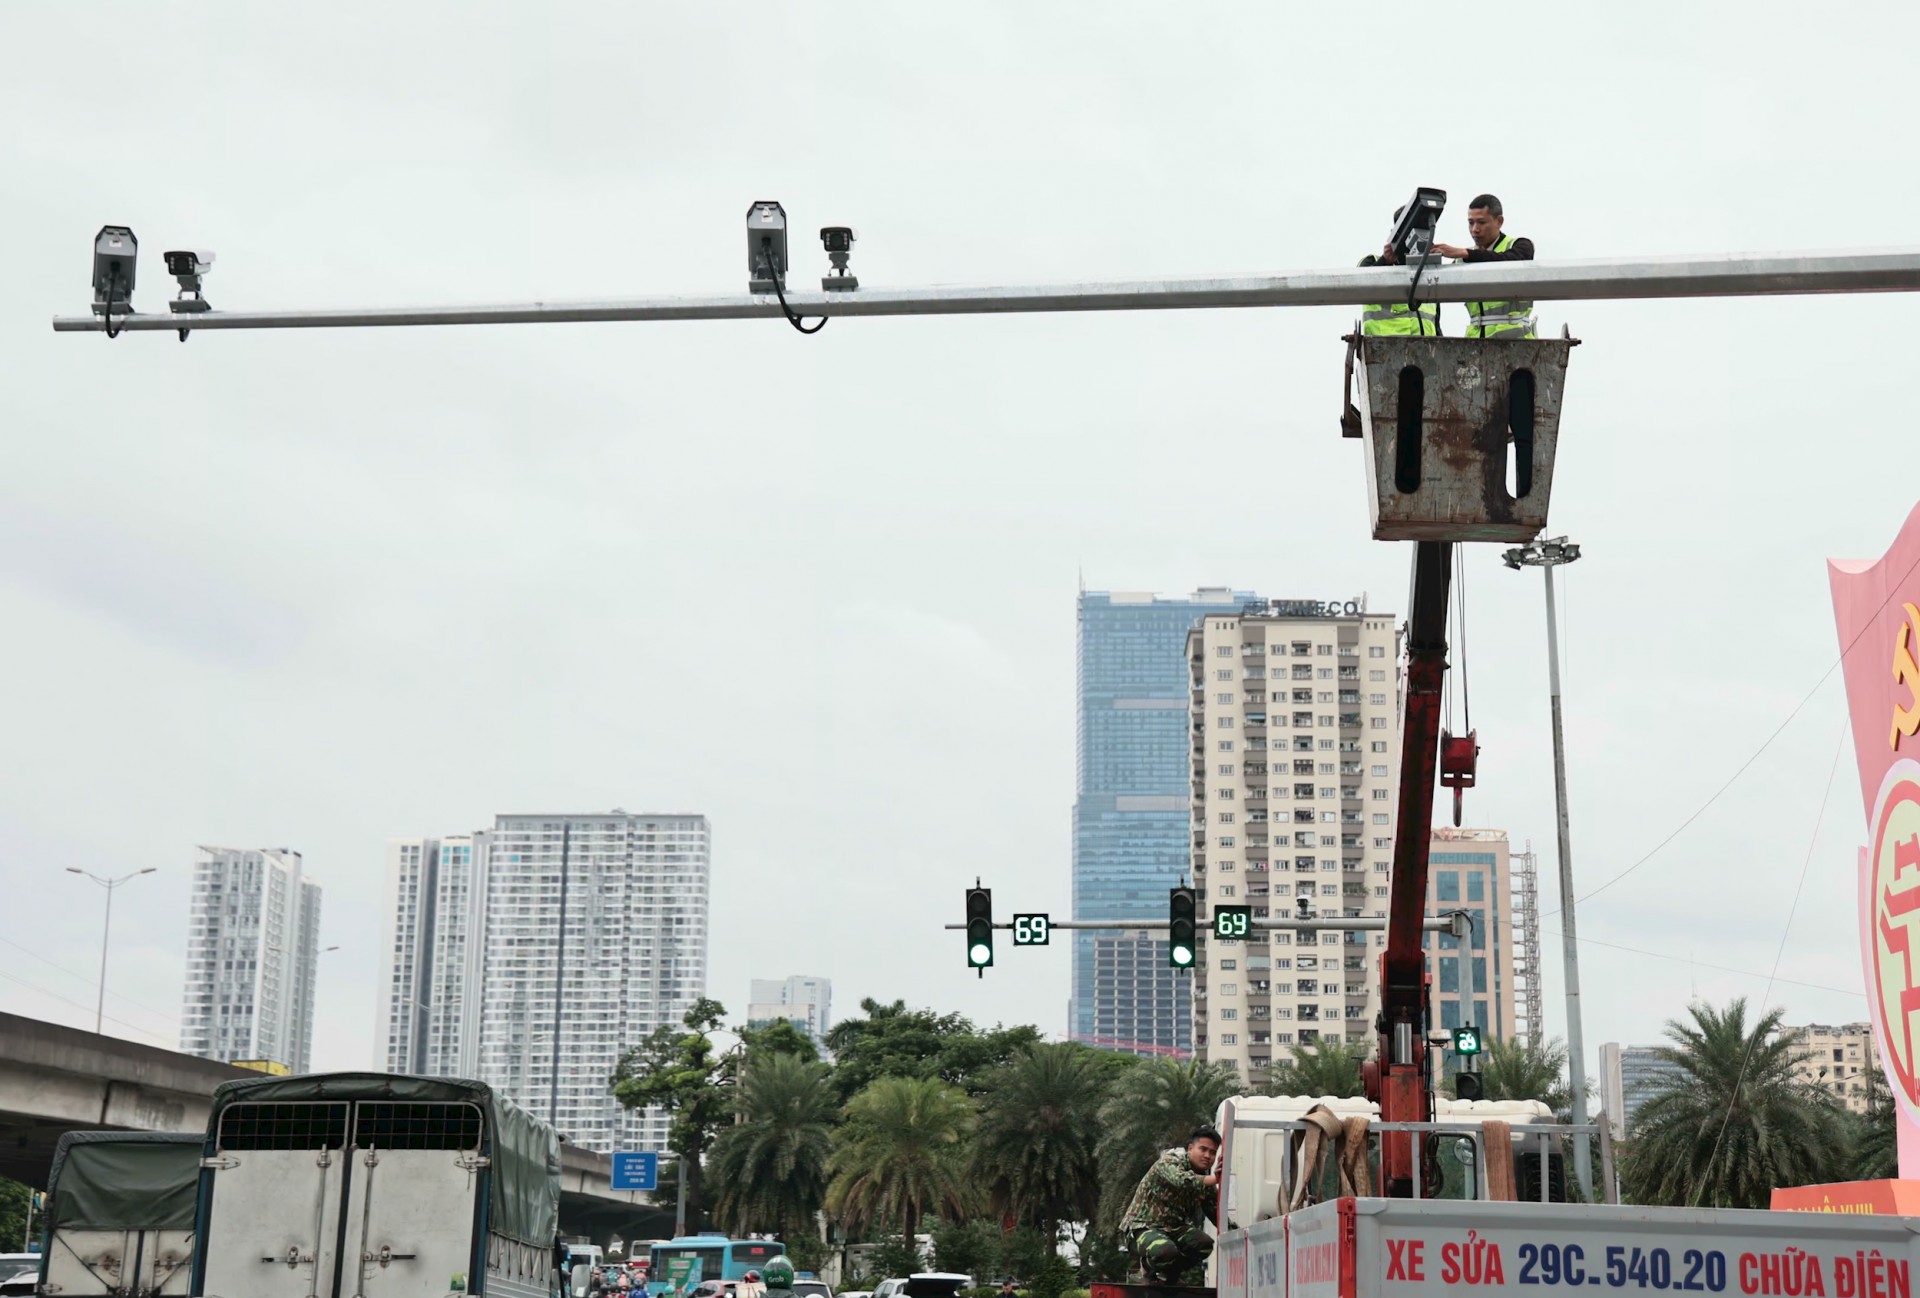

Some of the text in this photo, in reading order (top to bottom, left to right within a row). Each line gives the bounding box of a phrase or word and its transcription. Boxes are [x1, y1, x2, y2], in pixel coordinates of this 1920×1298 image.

[1015, 917, 1047, 942] 69
[1387, 1239, 1425, 1281] XE
[1441, 1229, 1505, 1285] SỬA
[1739, 1246, 1825, 1297] CHỮA
